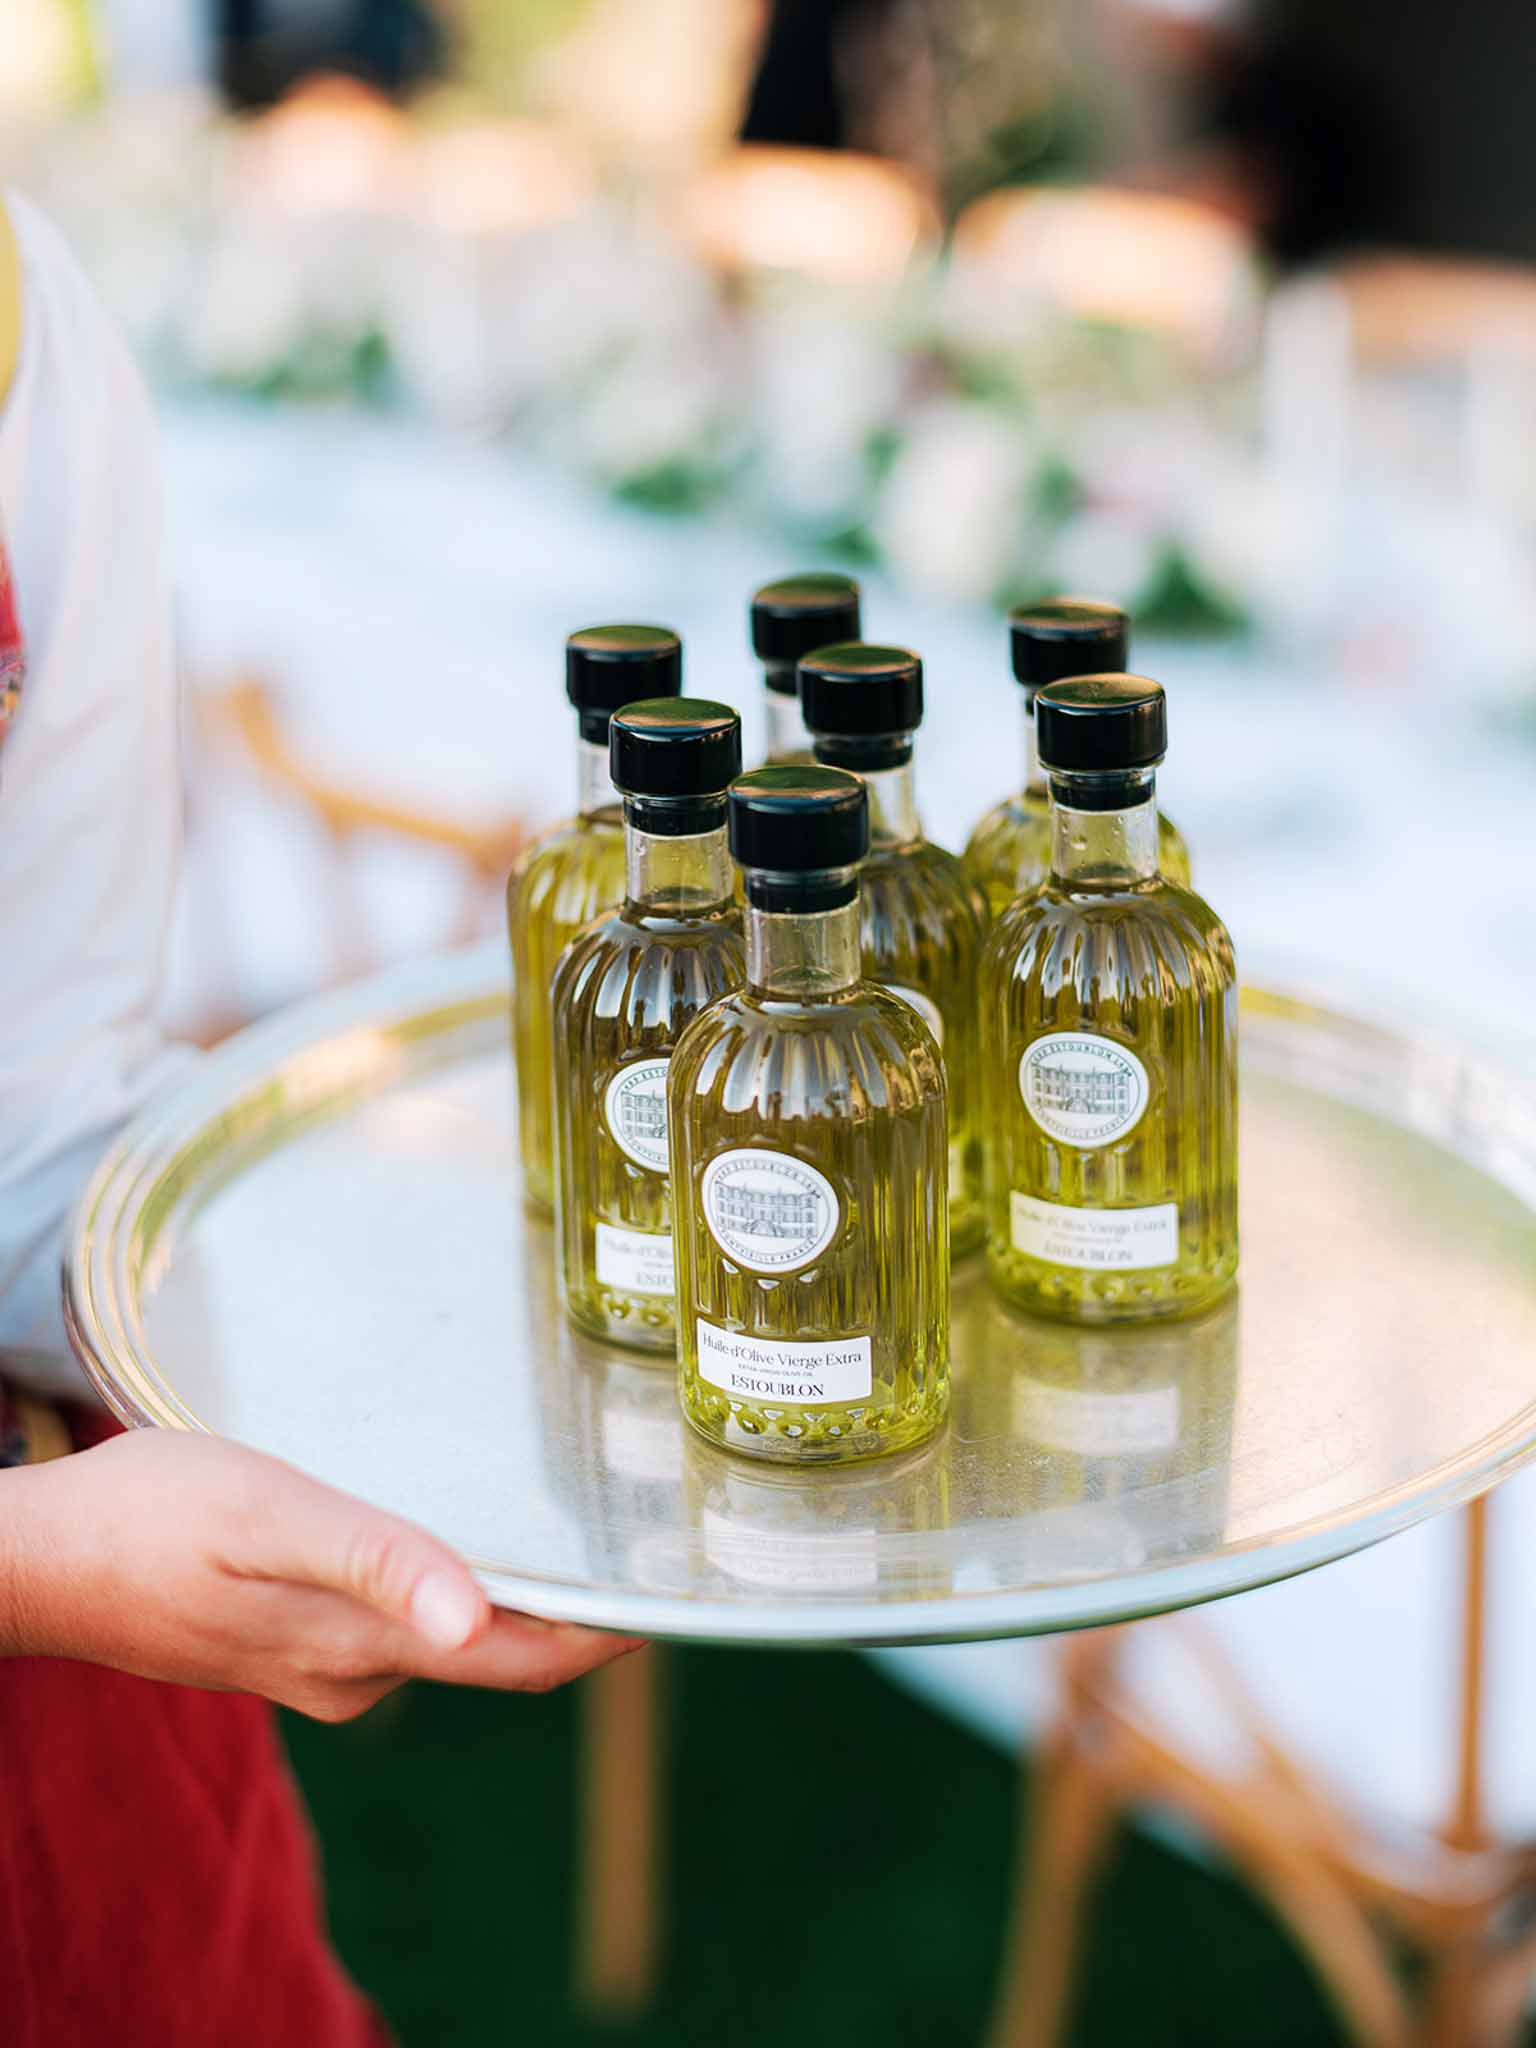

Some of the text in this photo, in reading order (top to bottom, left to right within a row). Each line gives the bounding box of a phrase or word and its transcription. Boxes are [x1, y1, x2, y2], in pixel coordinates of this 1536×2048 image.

[702, 1331, 862, 1370] Huile d'Olive Vierge Extra
[731, 1373, 824, 1397] ESTOUBLON
